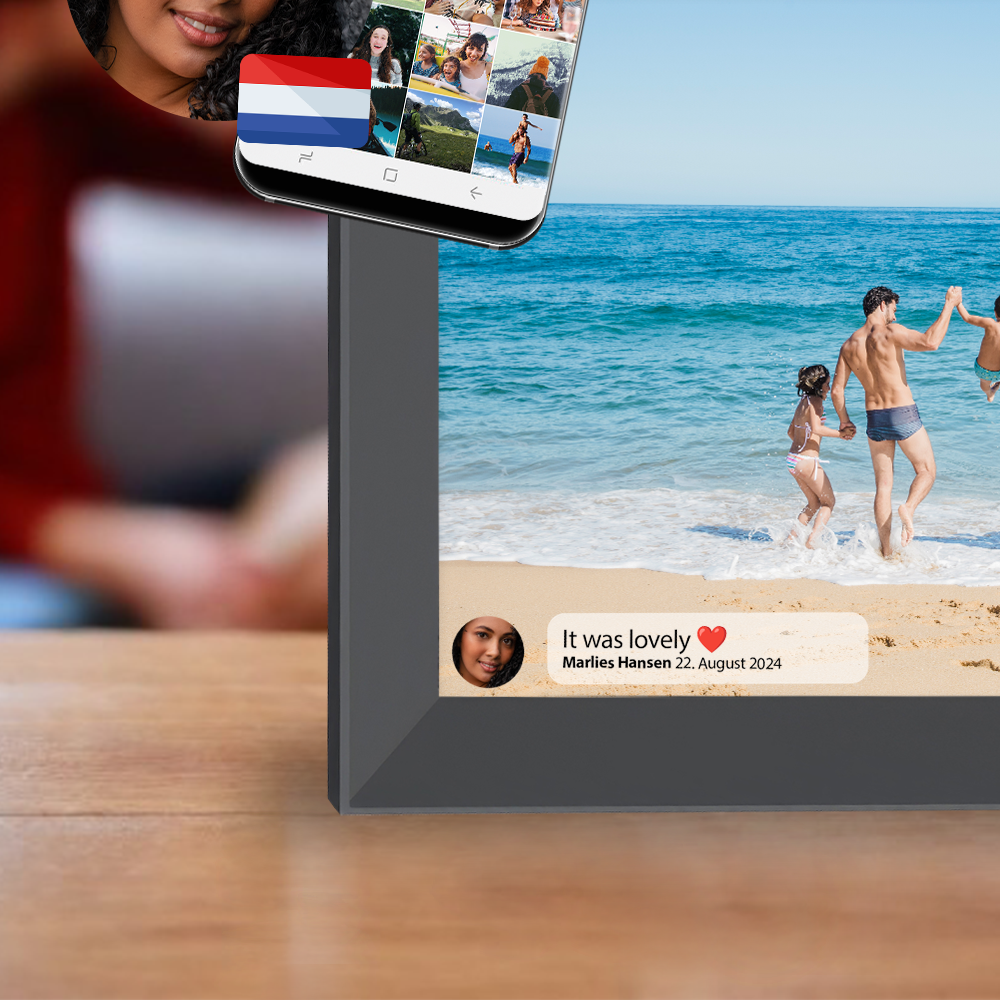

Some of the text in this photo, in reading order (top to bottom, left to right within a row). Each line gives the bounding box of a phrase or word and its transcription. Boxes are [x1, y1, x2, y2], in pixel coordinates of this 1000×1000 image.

[563, 629, 691, 655] It was lovely
[562, 656, 783, 673] Marlies Hansen 22. August 2024
